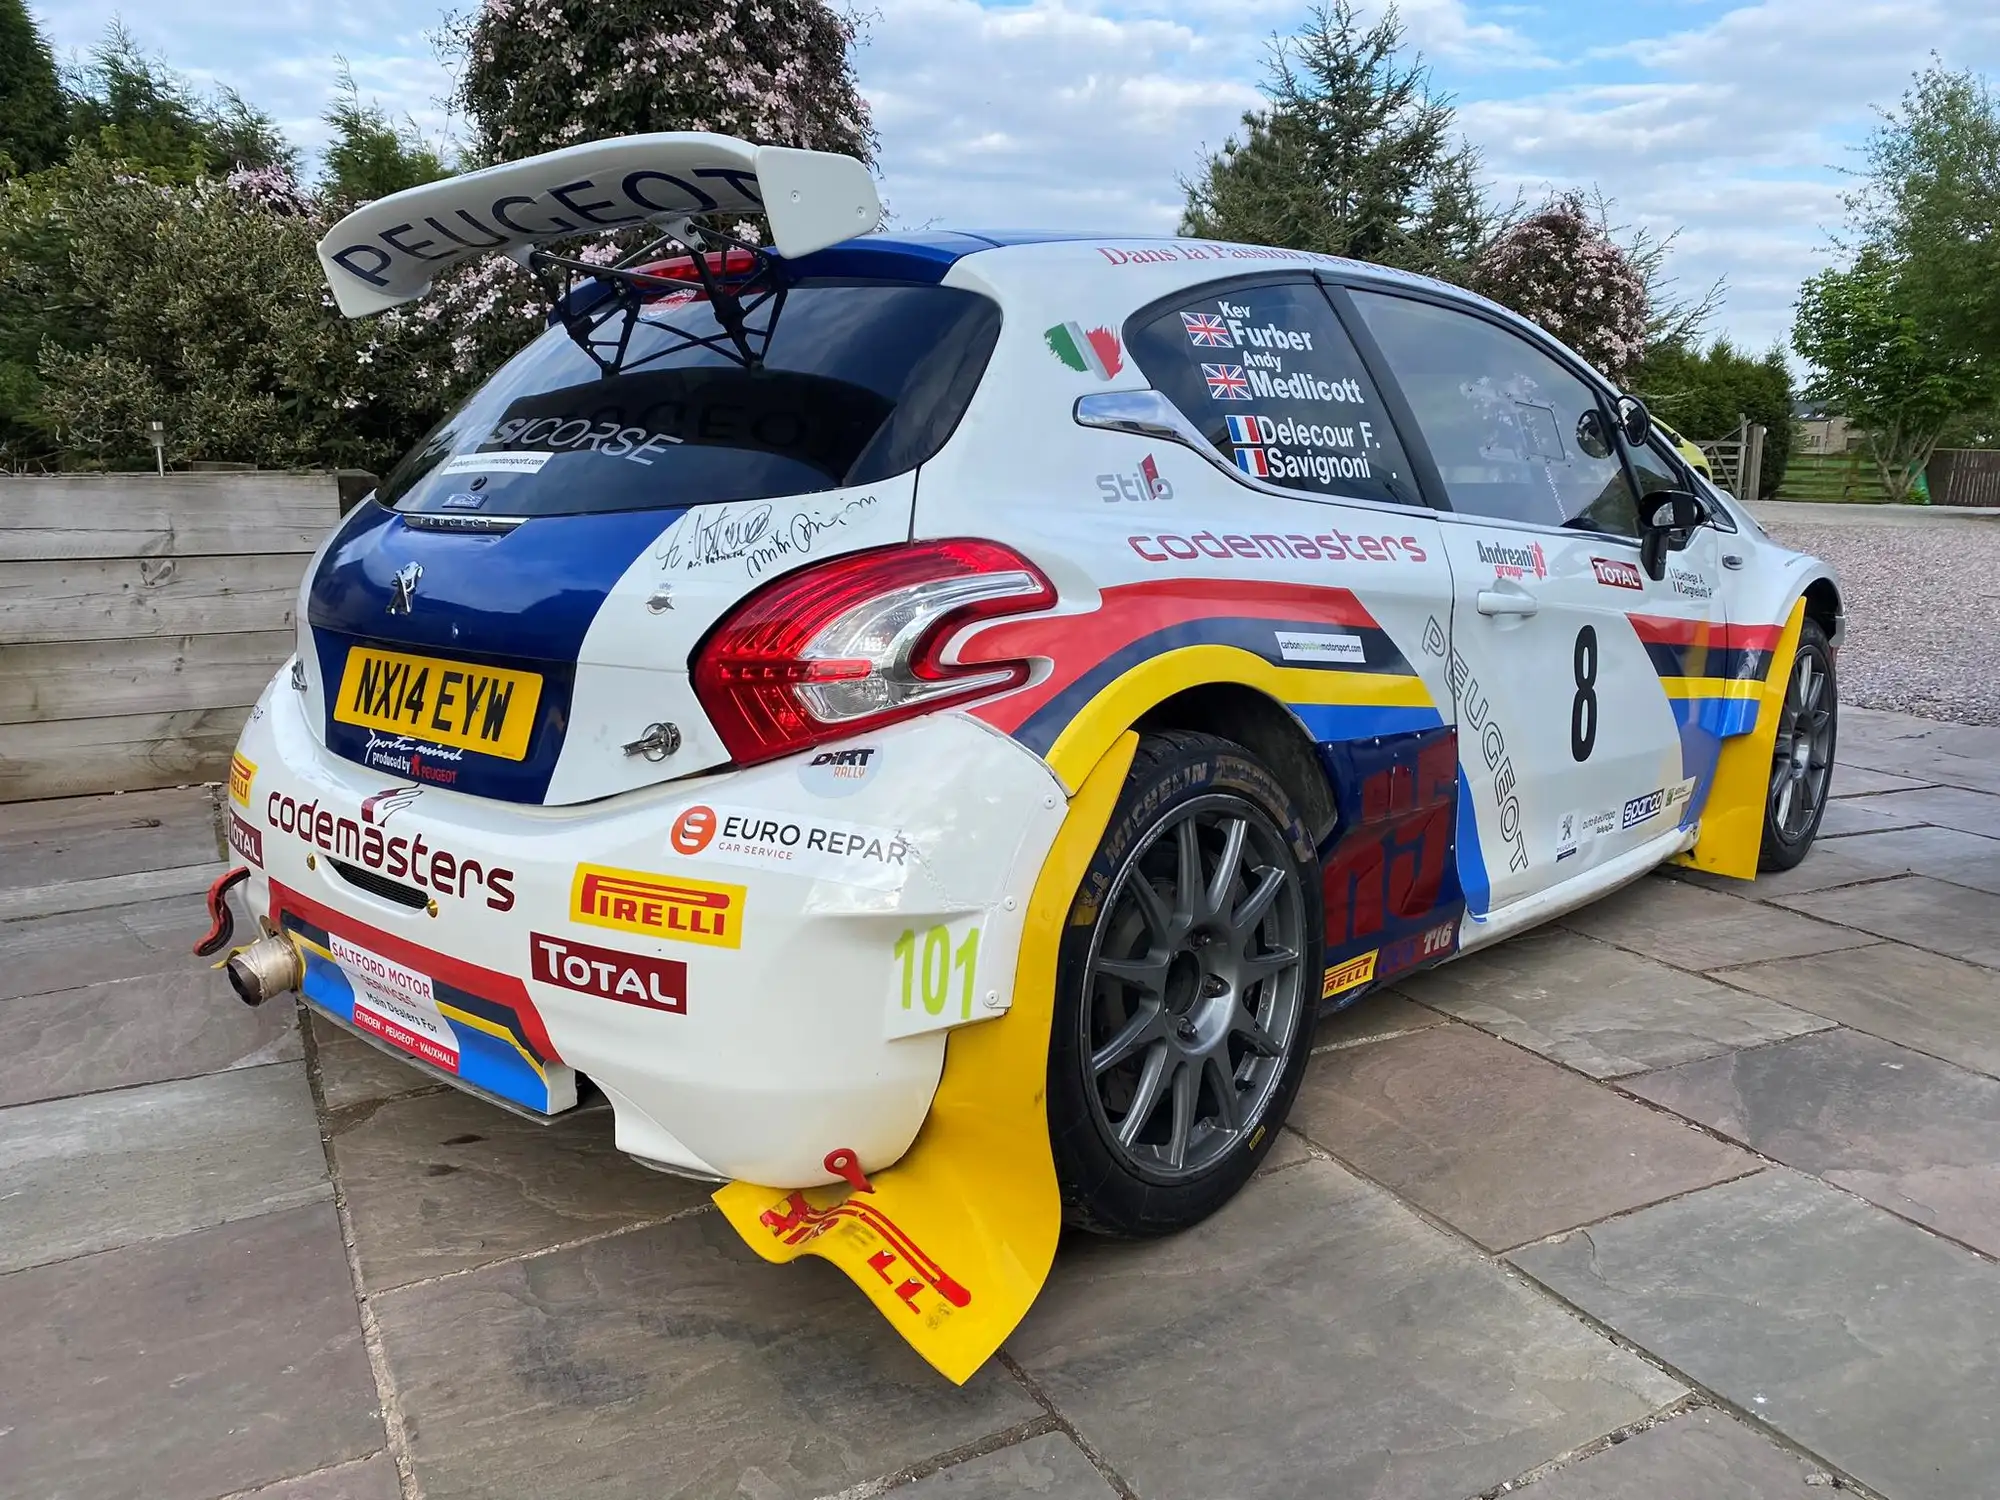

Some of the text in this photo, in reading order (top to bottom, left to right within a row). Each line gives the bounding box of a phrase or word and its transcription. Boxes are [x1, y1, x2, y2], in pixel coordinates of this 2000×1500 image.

[331, 168, 764, 287] PEUGEOT
[1096, 247, 1178, 266] Dans
[1173, 244, 1206, 260] la
[1218, 301, 1251, 319] Kev
[1226, 319, 1313, 351] Furber
[1242, 351, 1282, 373] Andy
[1246, 369, 1365, 404] Medlicott
[1257, 415, 1380, 448] Delecour F.
[1267, 448, 1371, 485] Savignoni
[1127, 528, 1427, 563] codemasters
[1476, 540, 1535, 567] Andreani
[1495, 565, 1524, 579] group
[1593, 561, 1641, 588] TOTAL
[353, 658, 515, 742] NX14 EYW
[1571, 624, 1598, 763] 8
[1421, 614, 1530, 874] PEUGEOT
[372, 752, 458, 784] produced by PEUGEOT
[833, 766, 866, 778] RALLY
[1624, 790, 1663, 825] sparco
[230, 815, 262, 864] TOTAL
[267, 790, 516, 912] codemasters
[718, 841, 793, 861] CAR SERVICE
[722, 816, 907, 866] EURO REPAR
[580, 872, 731, 936] PIRELLI
[332, 942, 432, 999] SALTFORD MOTOR
[539, 939, 678, 1006] TOTAL
[894, 923, 980, 1021] 101
[366, 991, 438, 1034] Main Dealers For
[355, 1010, 381, 1029] CITROEN
[385, 1022, 415, 1047] PEUGEOT
[420, 1042, 456, 1067] VAUXHALL
